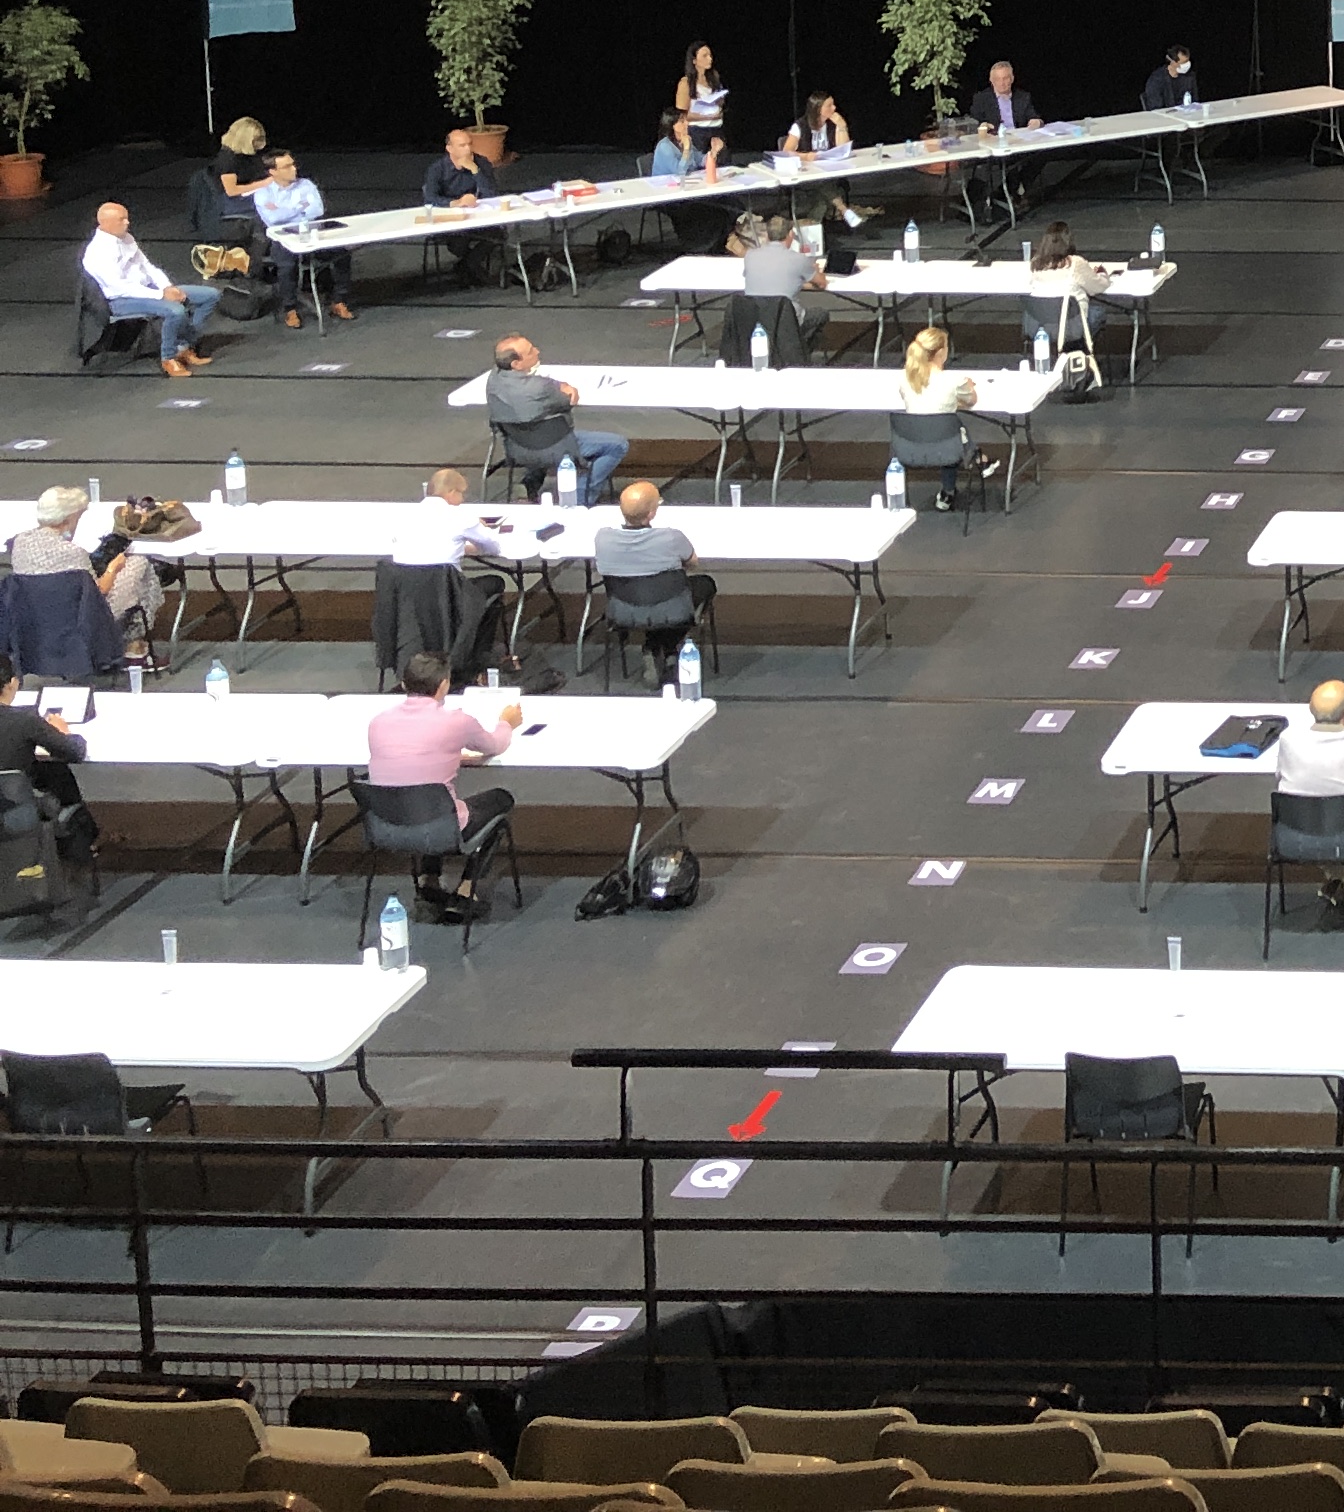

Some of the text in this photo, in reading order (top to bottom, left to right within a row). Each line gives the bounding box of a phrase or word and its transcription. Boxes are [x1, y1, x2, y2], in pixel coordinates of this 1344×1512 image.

[1277, 409, 1298, 419] F
[1240, 450, 1270, 461] G
[1207, 494, 1239, 506] H
[1180, 540, 1196, 552] I
[1128, 591, 1152, 605] J
[1078, 650, 1113, 665] K
[1036, 712, 1058, 728] L
[975, 782, 1017, 798] M
[916, 860, 964, 879] N
[852, 946, 897, 967] O
[690, 1159, 741, 1189] Q
